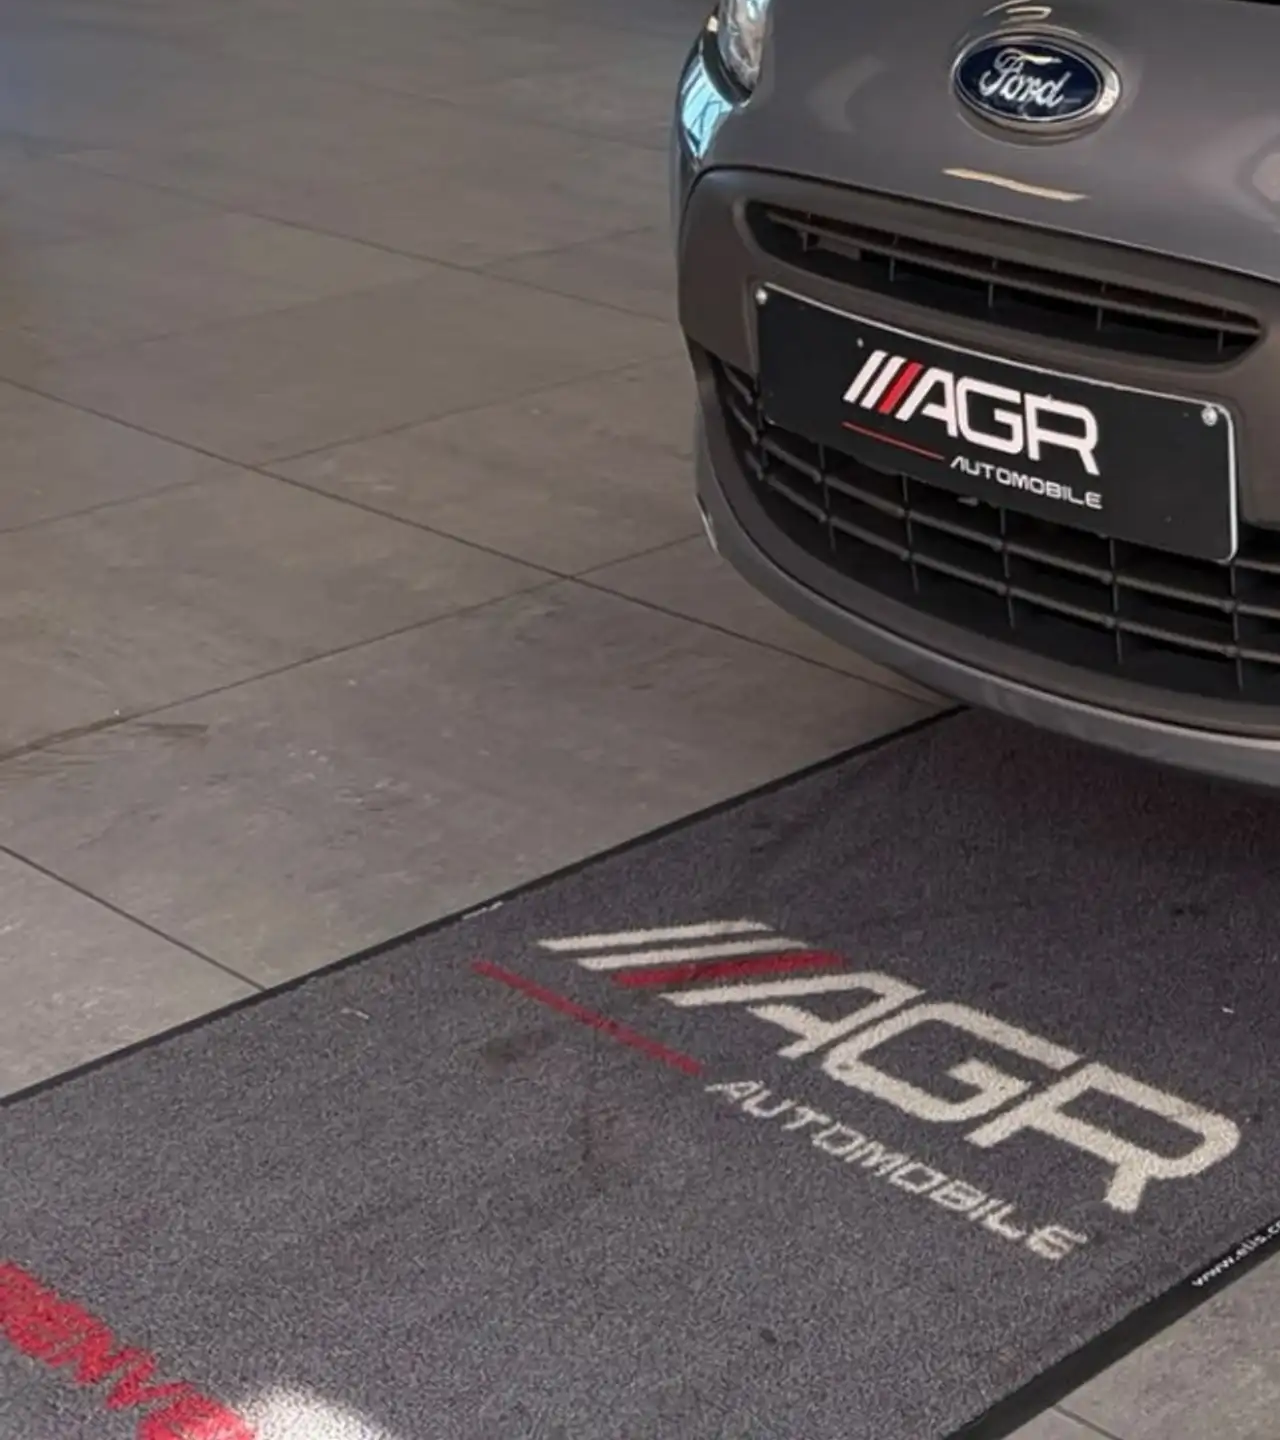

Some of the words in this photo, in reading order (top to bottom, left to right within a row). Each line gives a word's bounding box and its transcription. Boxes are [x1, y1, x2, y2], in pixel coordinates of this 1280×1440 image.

[979, 47, 1066, 108] Ford
[950, 455, 1103, 510] AUTOMOBILE
[706, 1079, 1088, 1262] AUTOMOBILE
